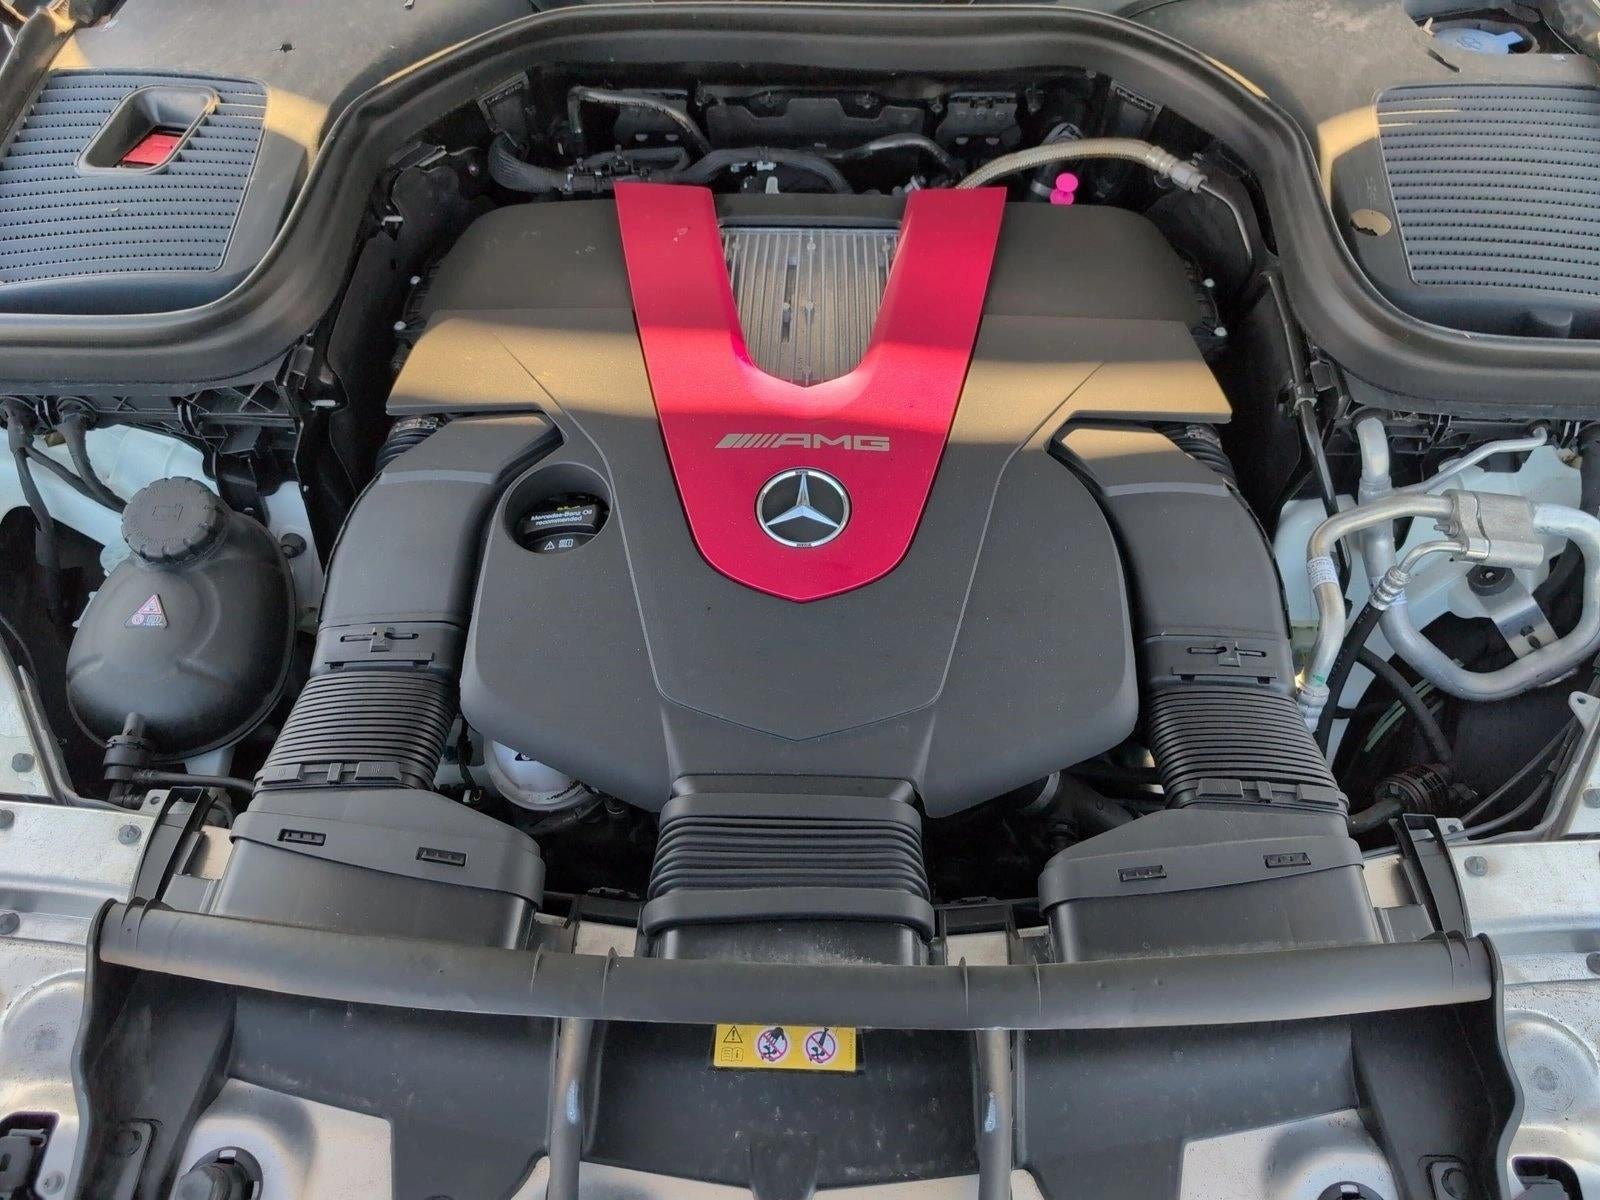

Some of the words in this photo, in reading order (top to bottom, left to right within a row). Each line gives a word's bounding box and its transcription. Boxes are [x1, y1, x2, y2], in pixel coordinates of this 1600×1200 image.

[770, 433, 890, 452] AMG
[530, 511, 581, 521] Mercedes-Benz
[535, 515, 583, 526] recommended
